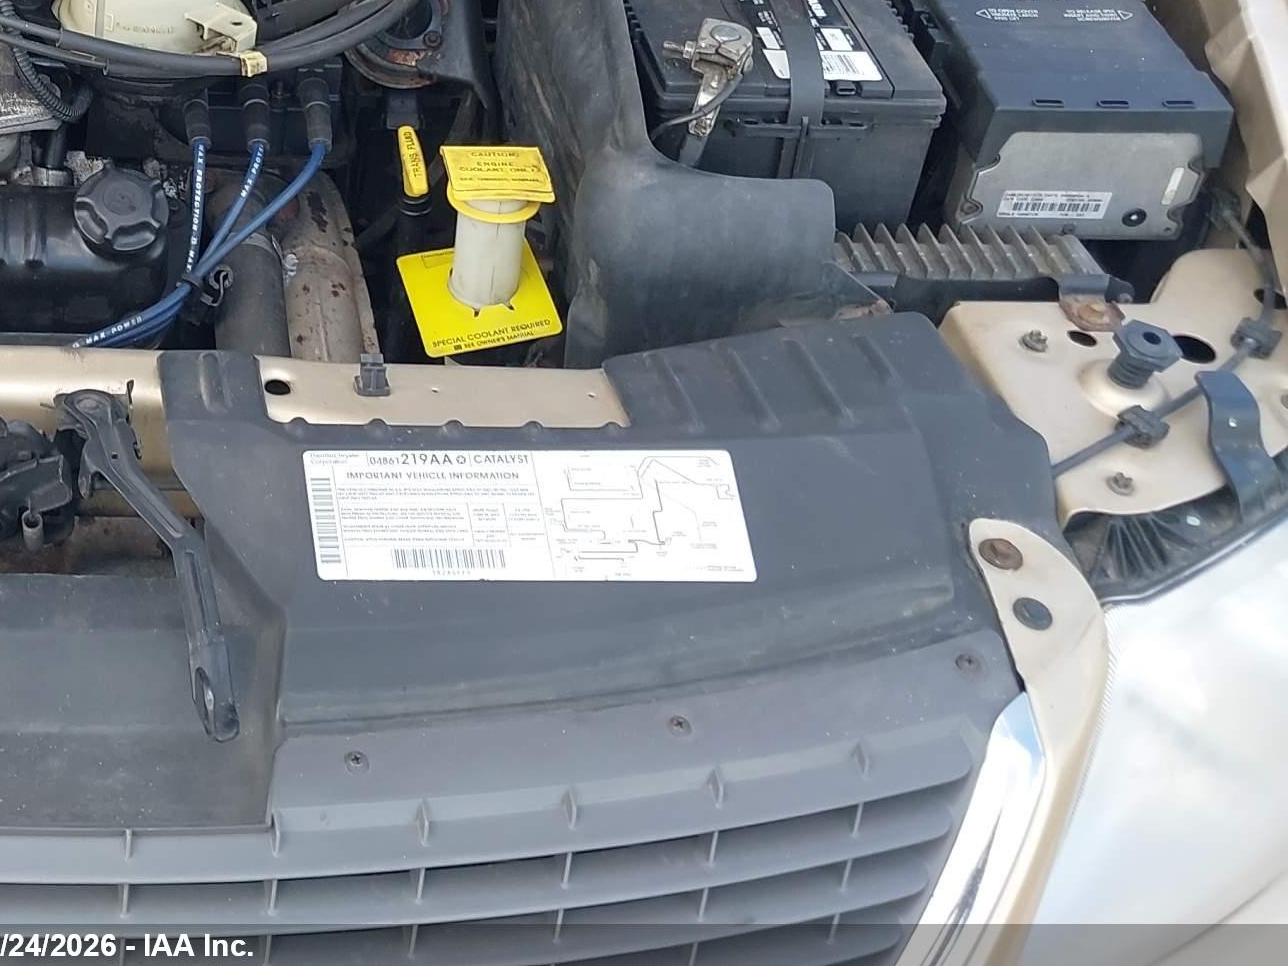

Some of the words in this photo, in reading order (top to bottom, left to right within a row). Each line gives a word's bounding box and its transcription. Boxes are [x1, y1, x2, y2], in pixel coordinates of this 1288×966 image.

[432, 337, 465, 348] SPECIAL
[467, 327, 509, 341] COOLANT
[511, 319, 551, 331] REQUIRED
[473, 454, 529, 465] CATALYST
[346, 471, 403, 480] IMPORTANT
[406, 471, 447, 480] VEHICLE
[449, 472, 520, 480] INFORMATION
